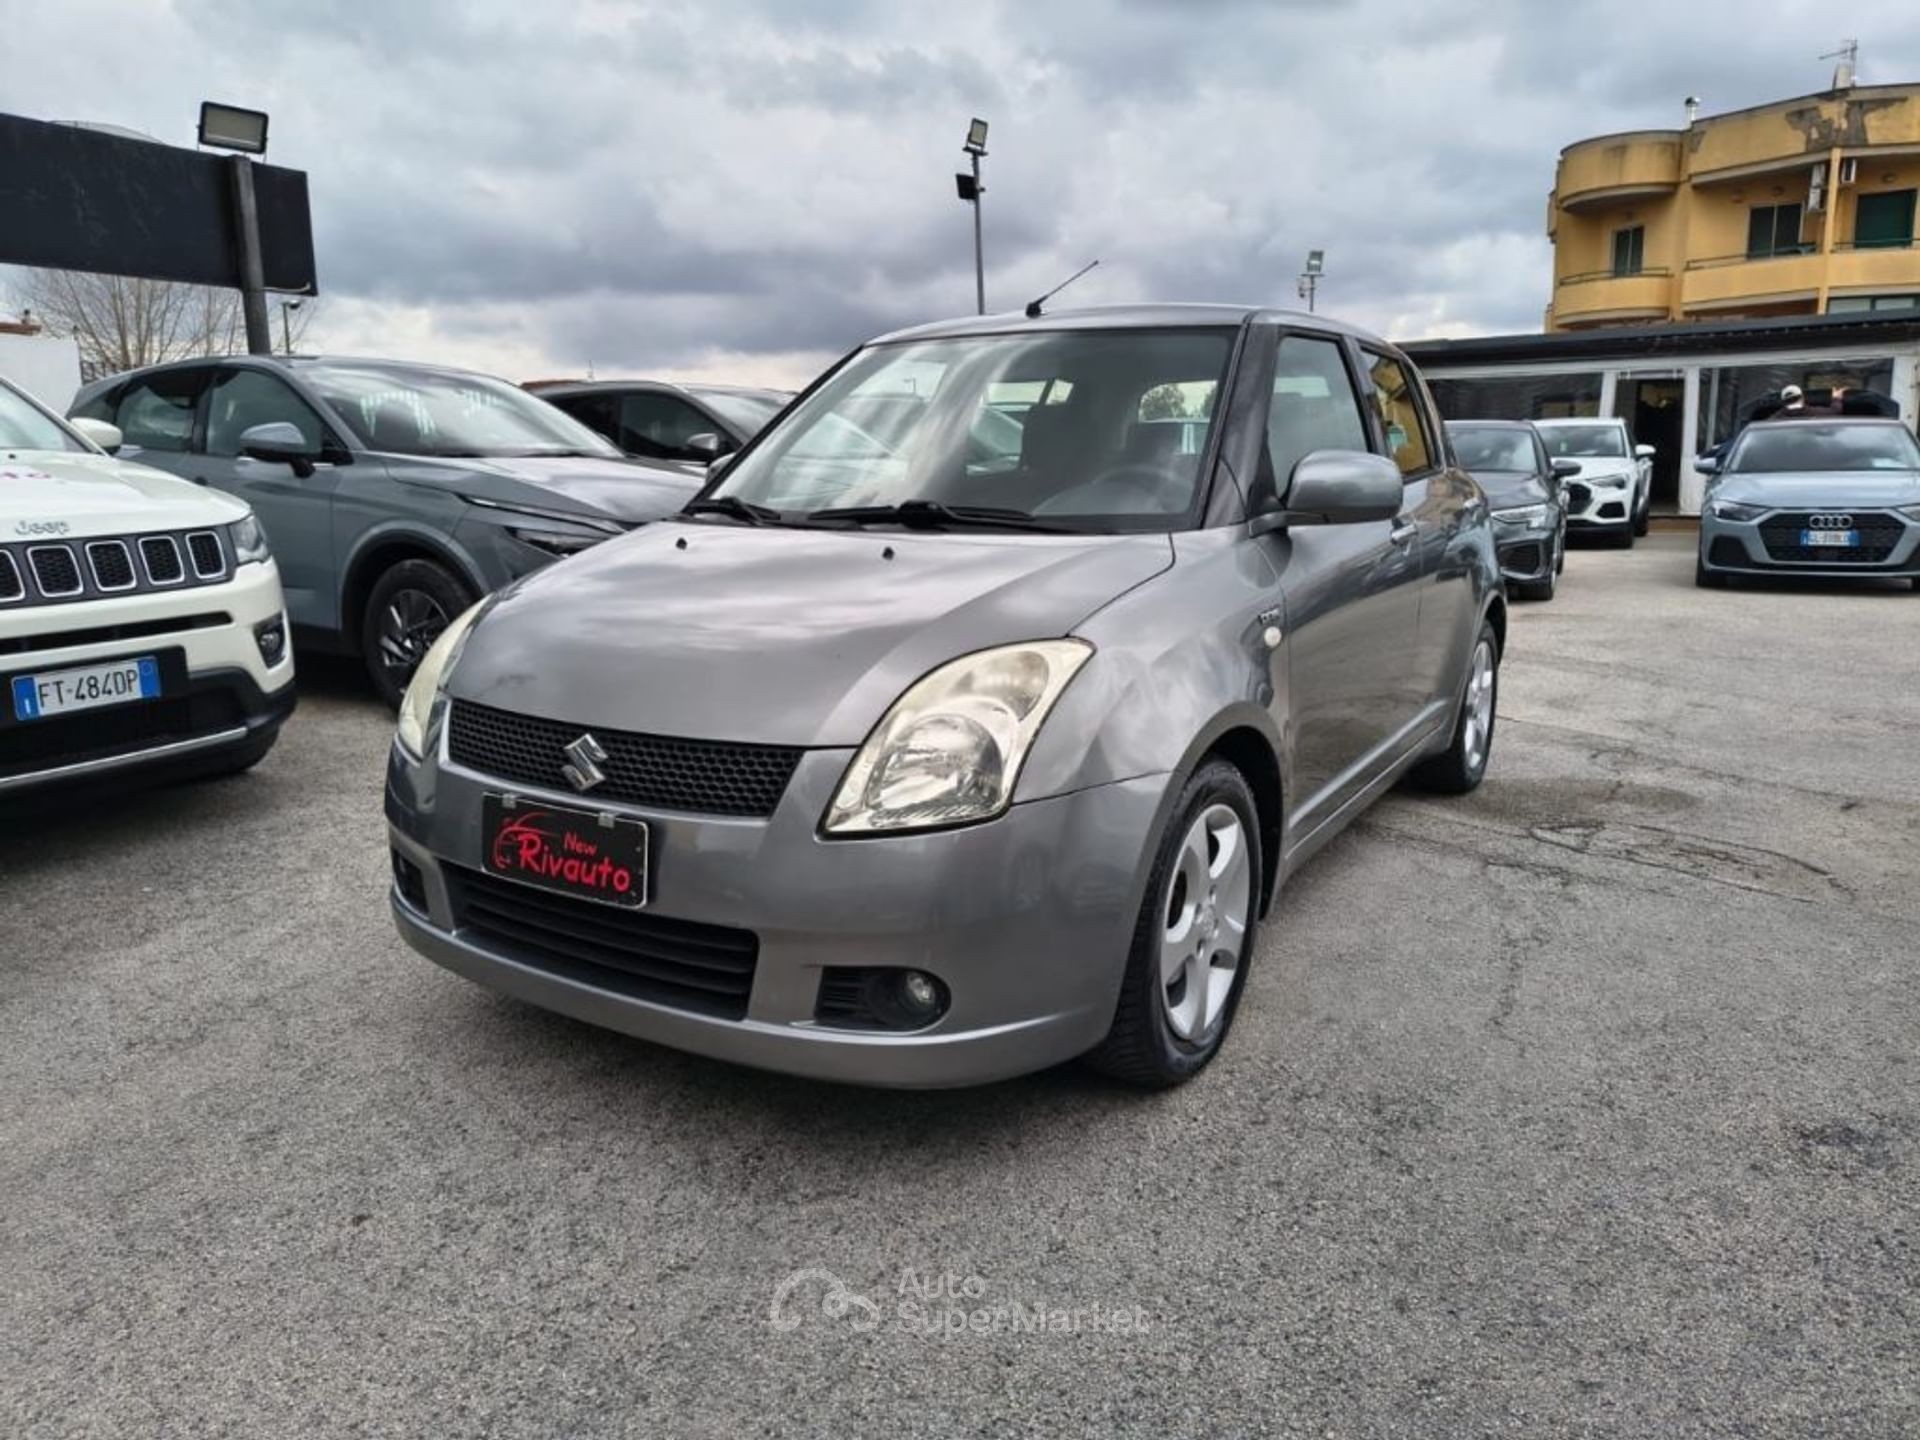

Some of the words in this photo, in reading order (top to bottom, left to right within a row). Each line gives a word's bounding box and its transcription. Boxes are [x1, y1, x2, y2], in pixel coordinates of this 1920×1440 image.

[15, 520, 69, 536] Jeep
[564, 832, 597, 855] New
[517, 833, 630, 893] Rivauto
